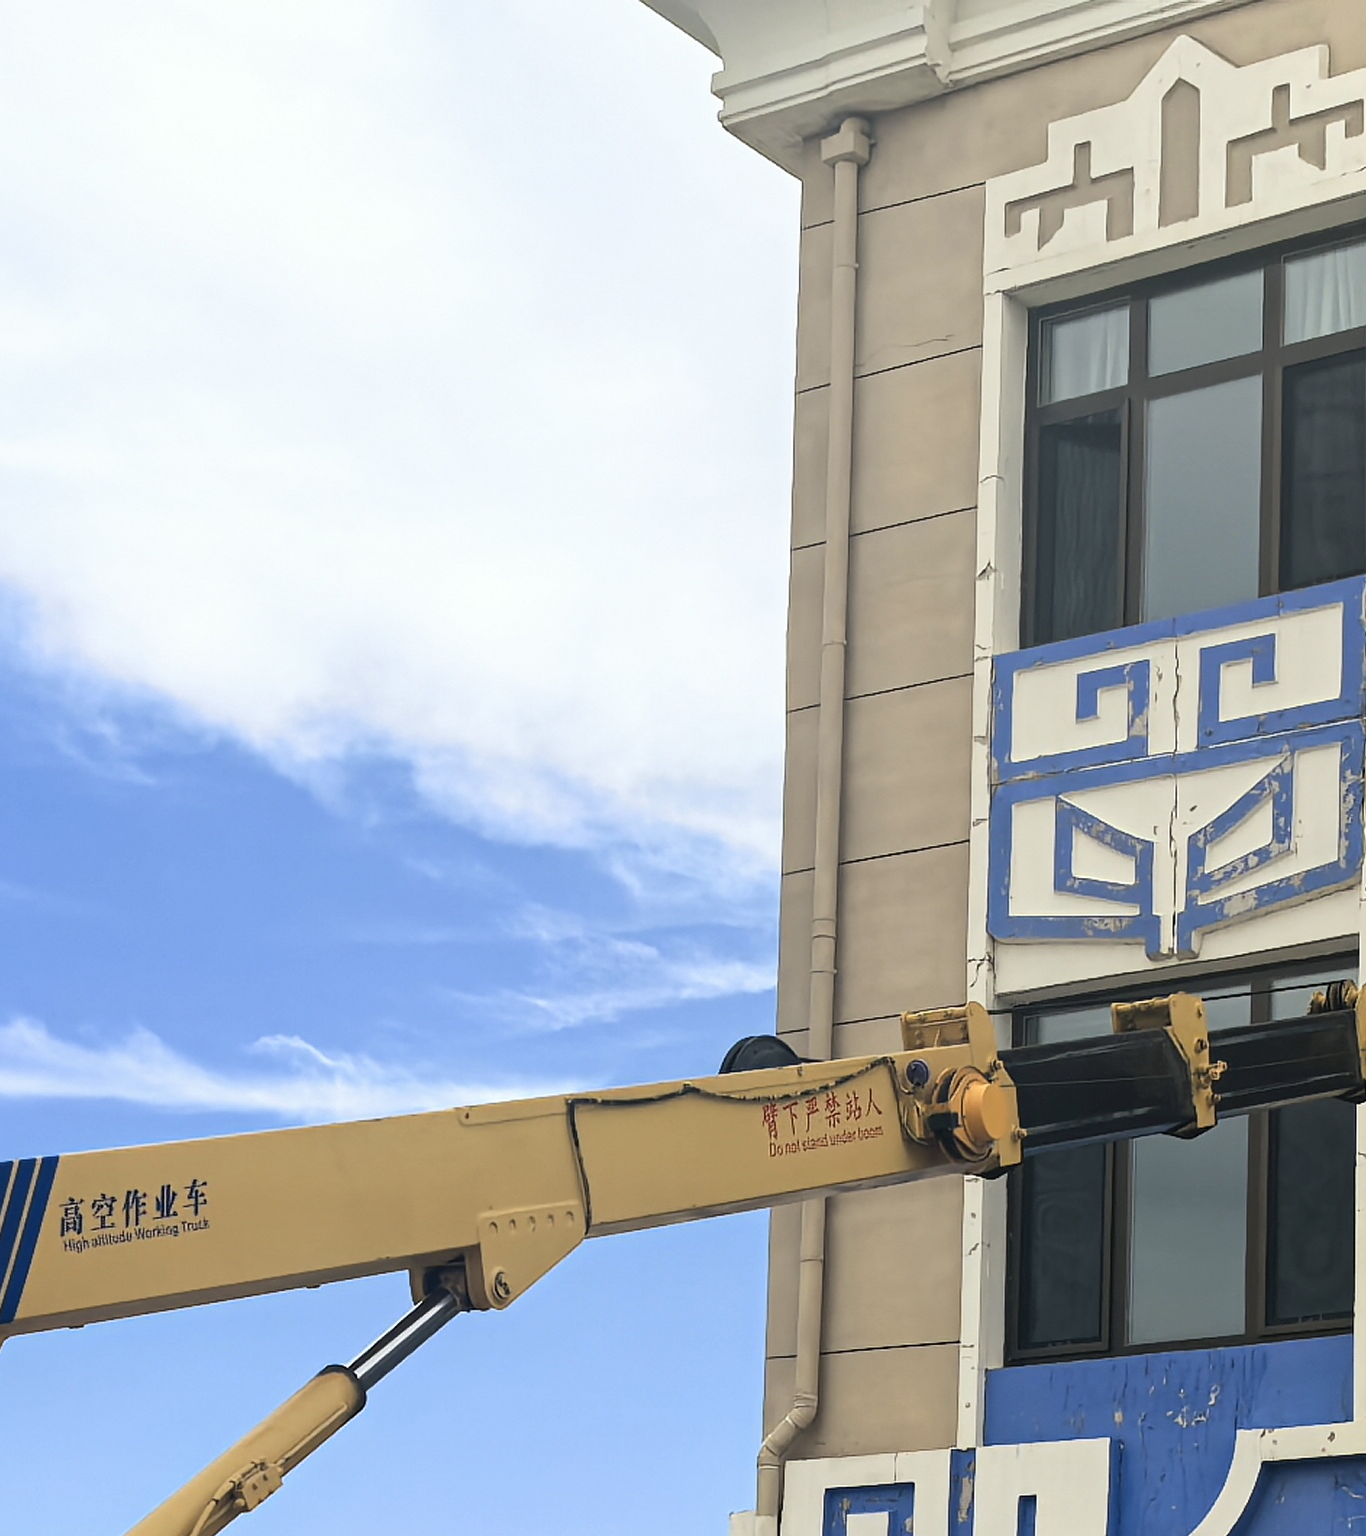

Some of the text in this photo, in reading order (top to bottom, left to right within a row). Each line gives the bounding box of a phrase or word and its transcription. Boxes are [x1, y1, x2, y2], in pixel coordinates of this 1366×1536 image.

[762, 1088, 882, 1140] 臂下严禁站人
[769, 1142, 784, 1158] Do
[784, 1139, 801, 1155] not
[59, 1178, 208, 1237] 高空作业车
[63, 1238, 90, 1254] High
[135, 1224, 179, 1241] Working
[181, 1217, 210, 1232] Truck
